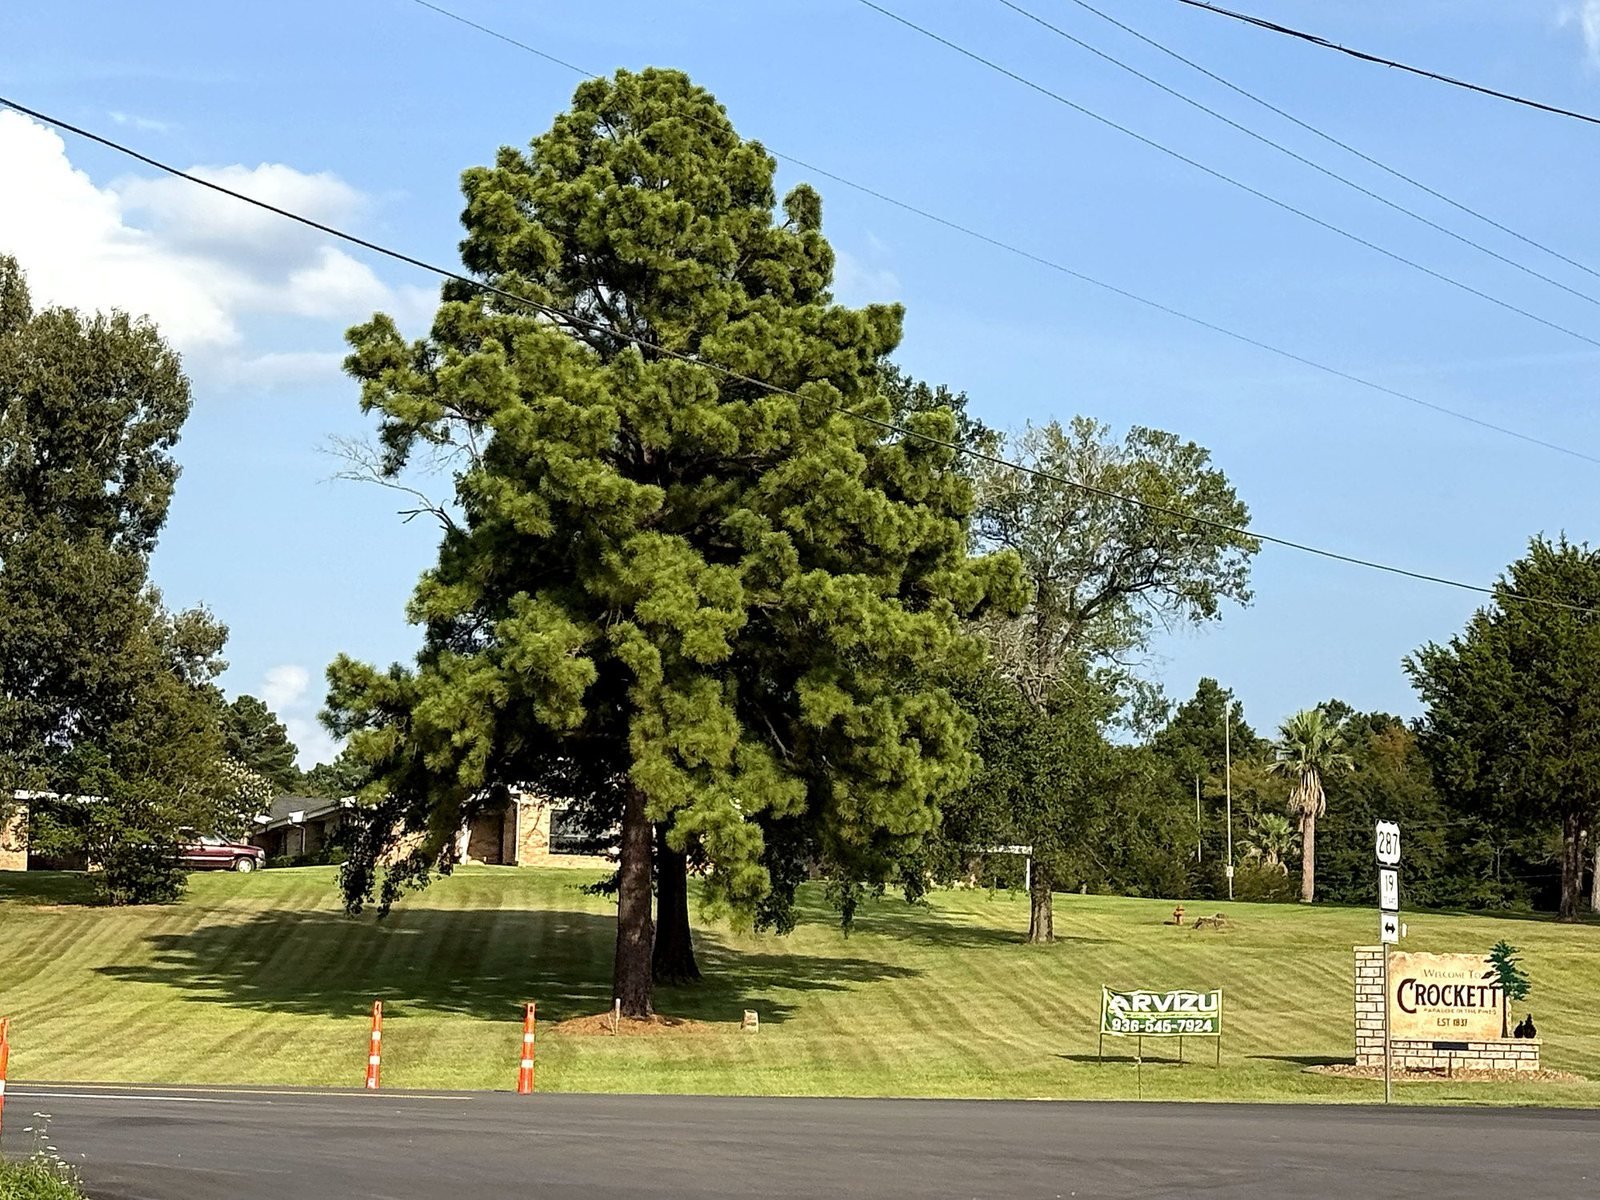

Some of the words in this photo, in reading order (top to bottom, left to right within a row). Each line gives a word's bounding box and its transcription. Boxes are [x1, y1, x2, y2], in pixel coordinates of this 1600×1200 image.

[1379, 830, 1398, 855] 287
[1385, 874, 1394, 892] 19
[1109, 993, 1218, 1012] ARVIZU
[1397, 978, 1502, 1014] CROCKETT
[1437, 1017, 1450, 1027] EST
